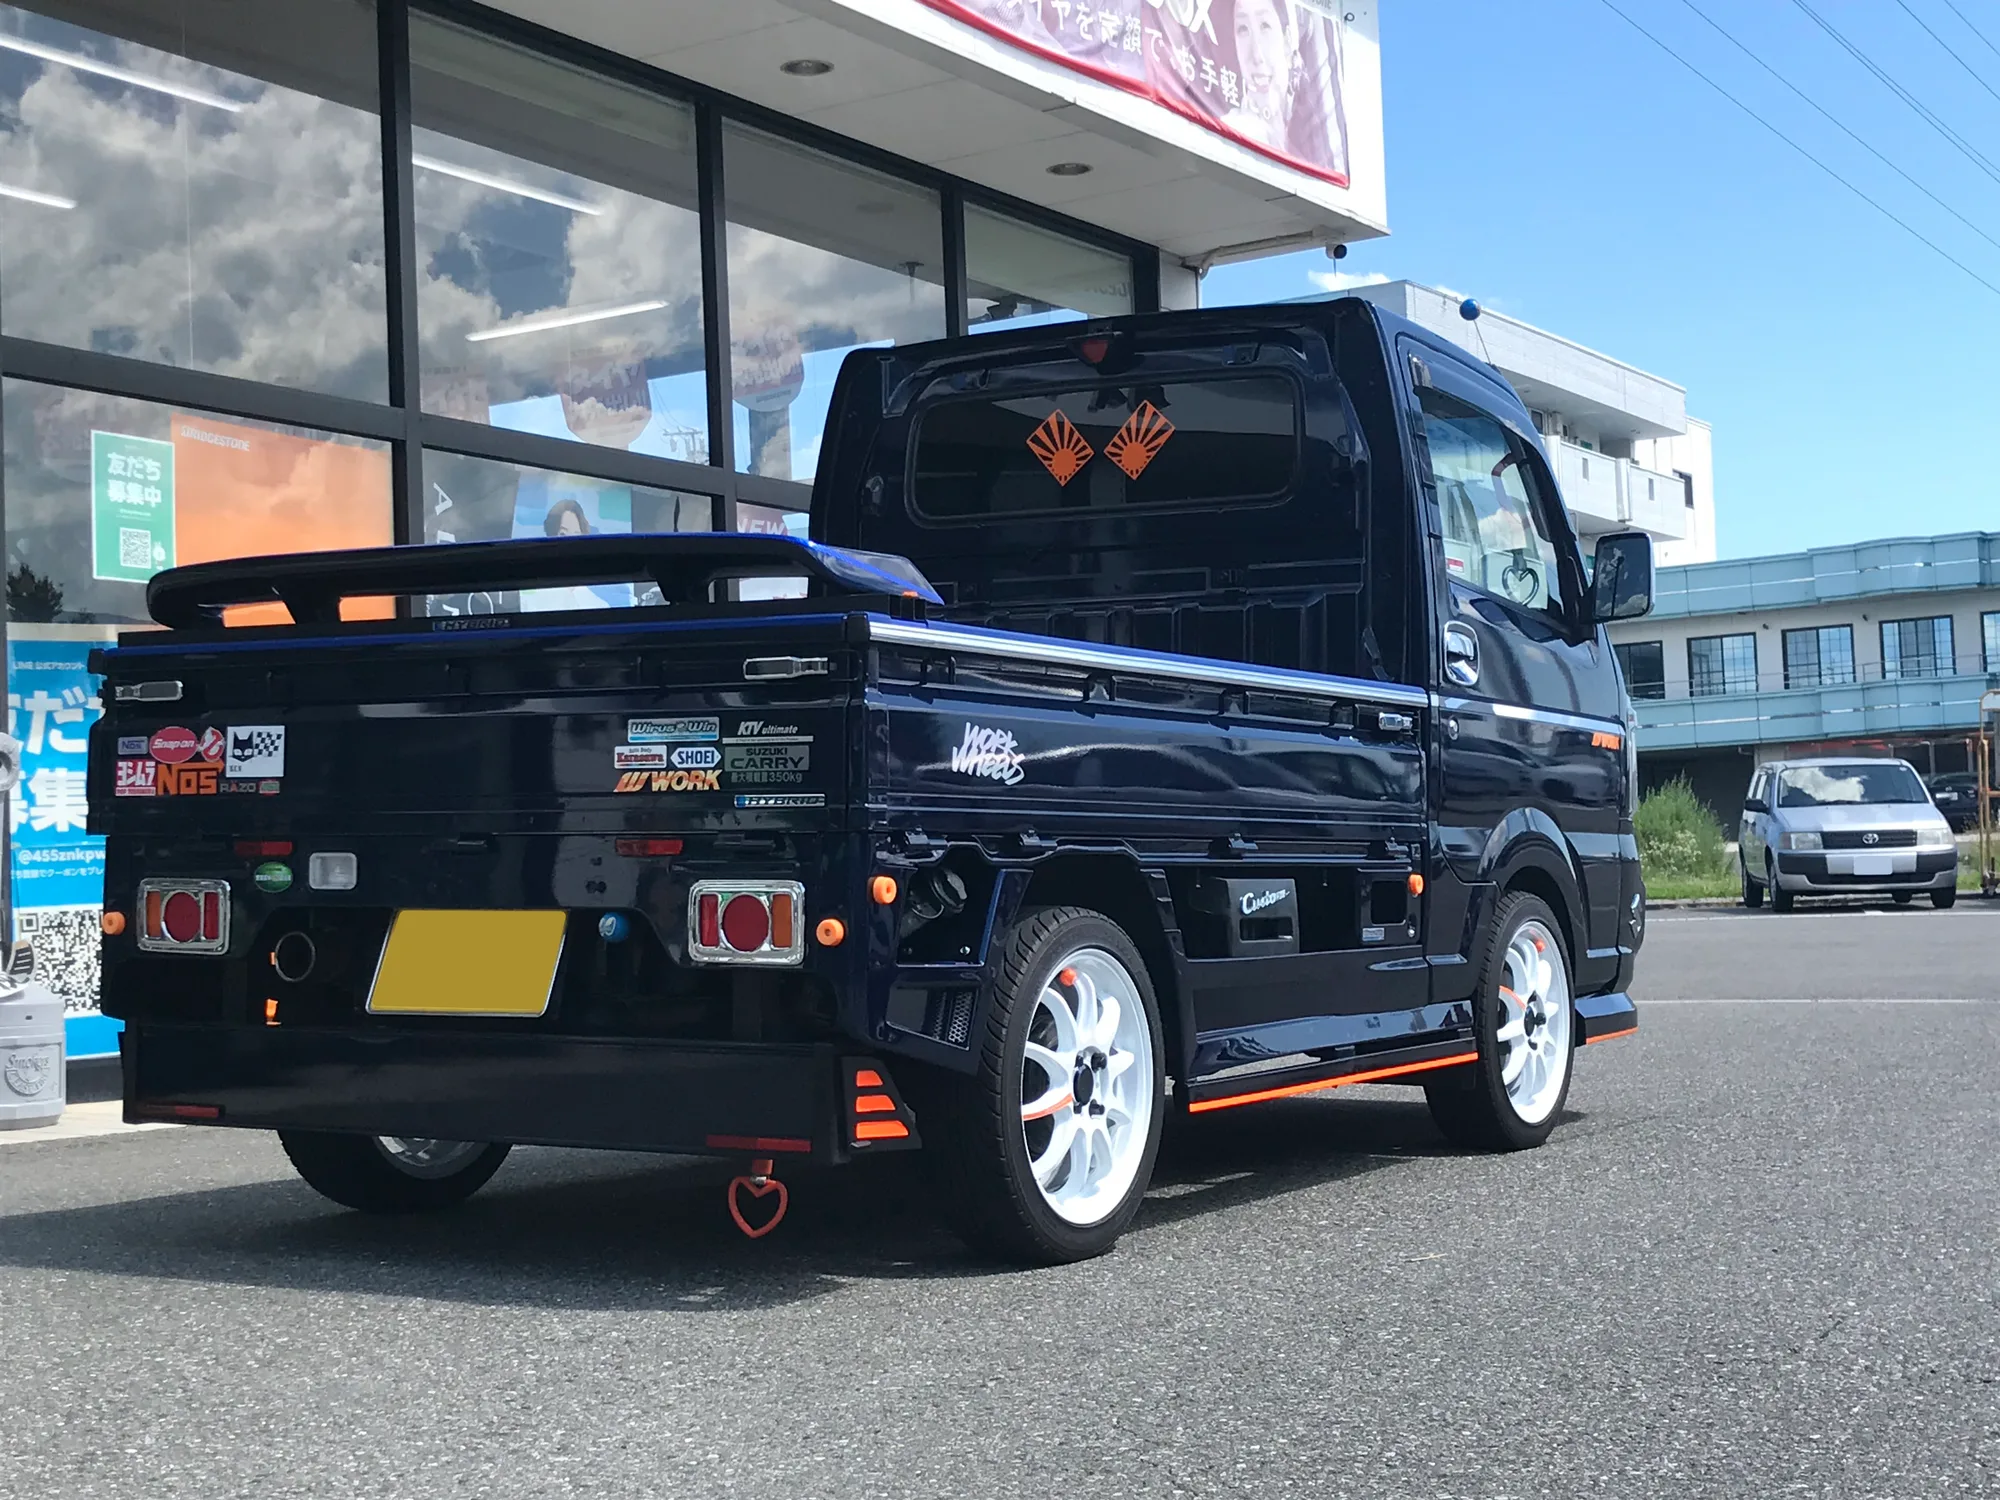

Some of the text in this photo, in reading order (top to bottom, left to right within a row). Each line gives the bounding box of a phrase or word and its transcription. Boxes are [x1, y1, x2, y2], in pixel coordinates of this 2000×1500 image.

[107, 452, 161, 481] 友だち
[687, 719, 718, 732] Win
[762, 725, 798, 734] ultimate
[677, 750, 715, 765] SHOEI
[745, 747, 788, 756] SUZUKI
[730, 757, 804, 769] CARRY
[117, 761, 156, 786] ヨシムラ
[650, 769, 723, 792] WORK
[1239, 889, 1291, 915] Custom
